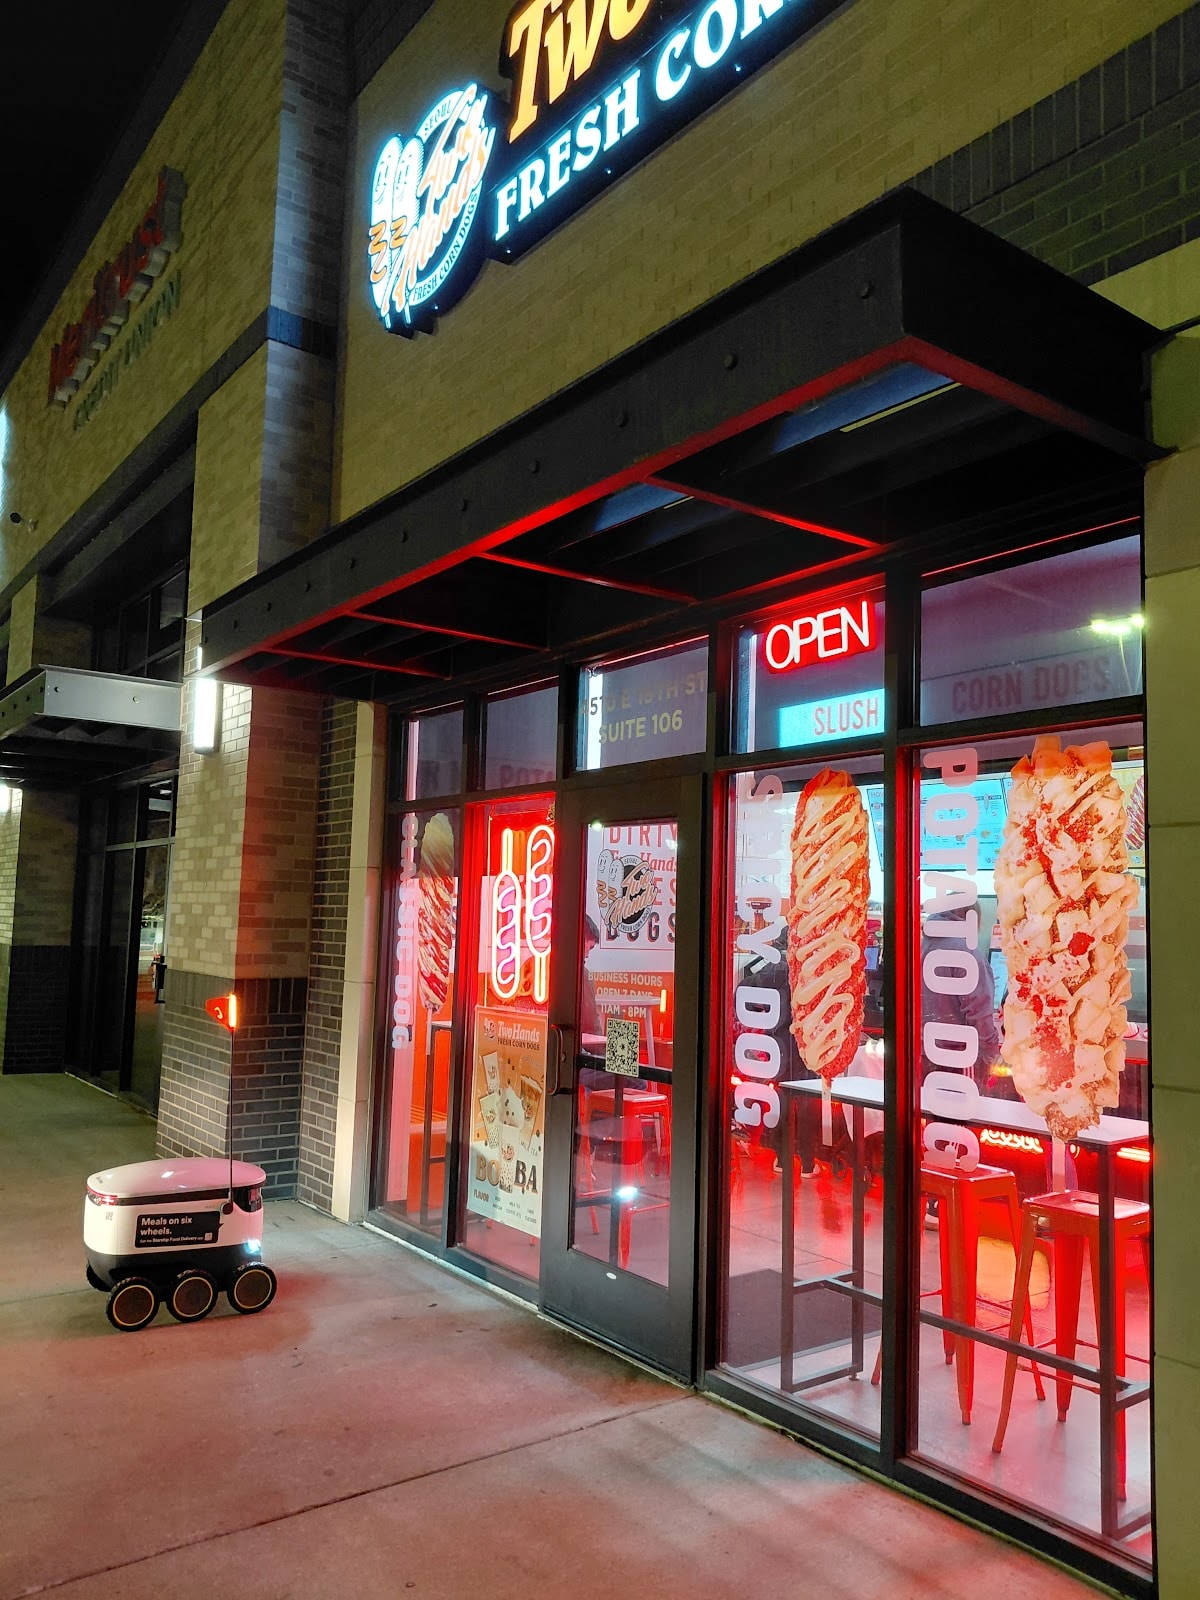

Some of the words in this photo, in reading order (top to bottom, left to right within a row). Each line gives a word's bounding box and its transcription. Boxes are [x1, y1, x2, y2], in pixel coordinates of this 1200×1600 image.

[495, 68, 641, 241] FRESH
[412, 277, 439, 302] FRESH
[438, 242, 462, 279] CORN
[460, 192, 478, 244] DOGS
[765, 600, 870, 669] OPEN
[952, 671, 1023, 715] CORN
[599, 717, 646, 744] SUITE
[651, 709, 683, 735] 106
[813, 696, 879, 737] SLUSH
[621, 861, 654, 900] Two
[640, 852, 677, 872] Hand
[735, 773, 783, 964] SPICY
[922, 746, 980, 996] POTATO
[396, 815, 419, 962] CLASSIC
[605, 884, 657, 928] Hands
[588, 971, 628, 984] BUSINESS
[631, 973, 663, 987] HOURS
[391, 974, 413, 1049] DOG
[601, 1003, 620, 1015] 11AM
[627, 1007, 647, 1018] 8PM
[512, 1039, 526, 1049] CORN
[526, 1042, 540, 1051] DOGS
[734, 985, 782, 1130] DOG
[921, 1022, 981, 1174] DOG
[140, 1227, 172, 1236] wheels.
[141, 1216, 167, 1226] Meals
[181, 1216, 193, 1224] six
